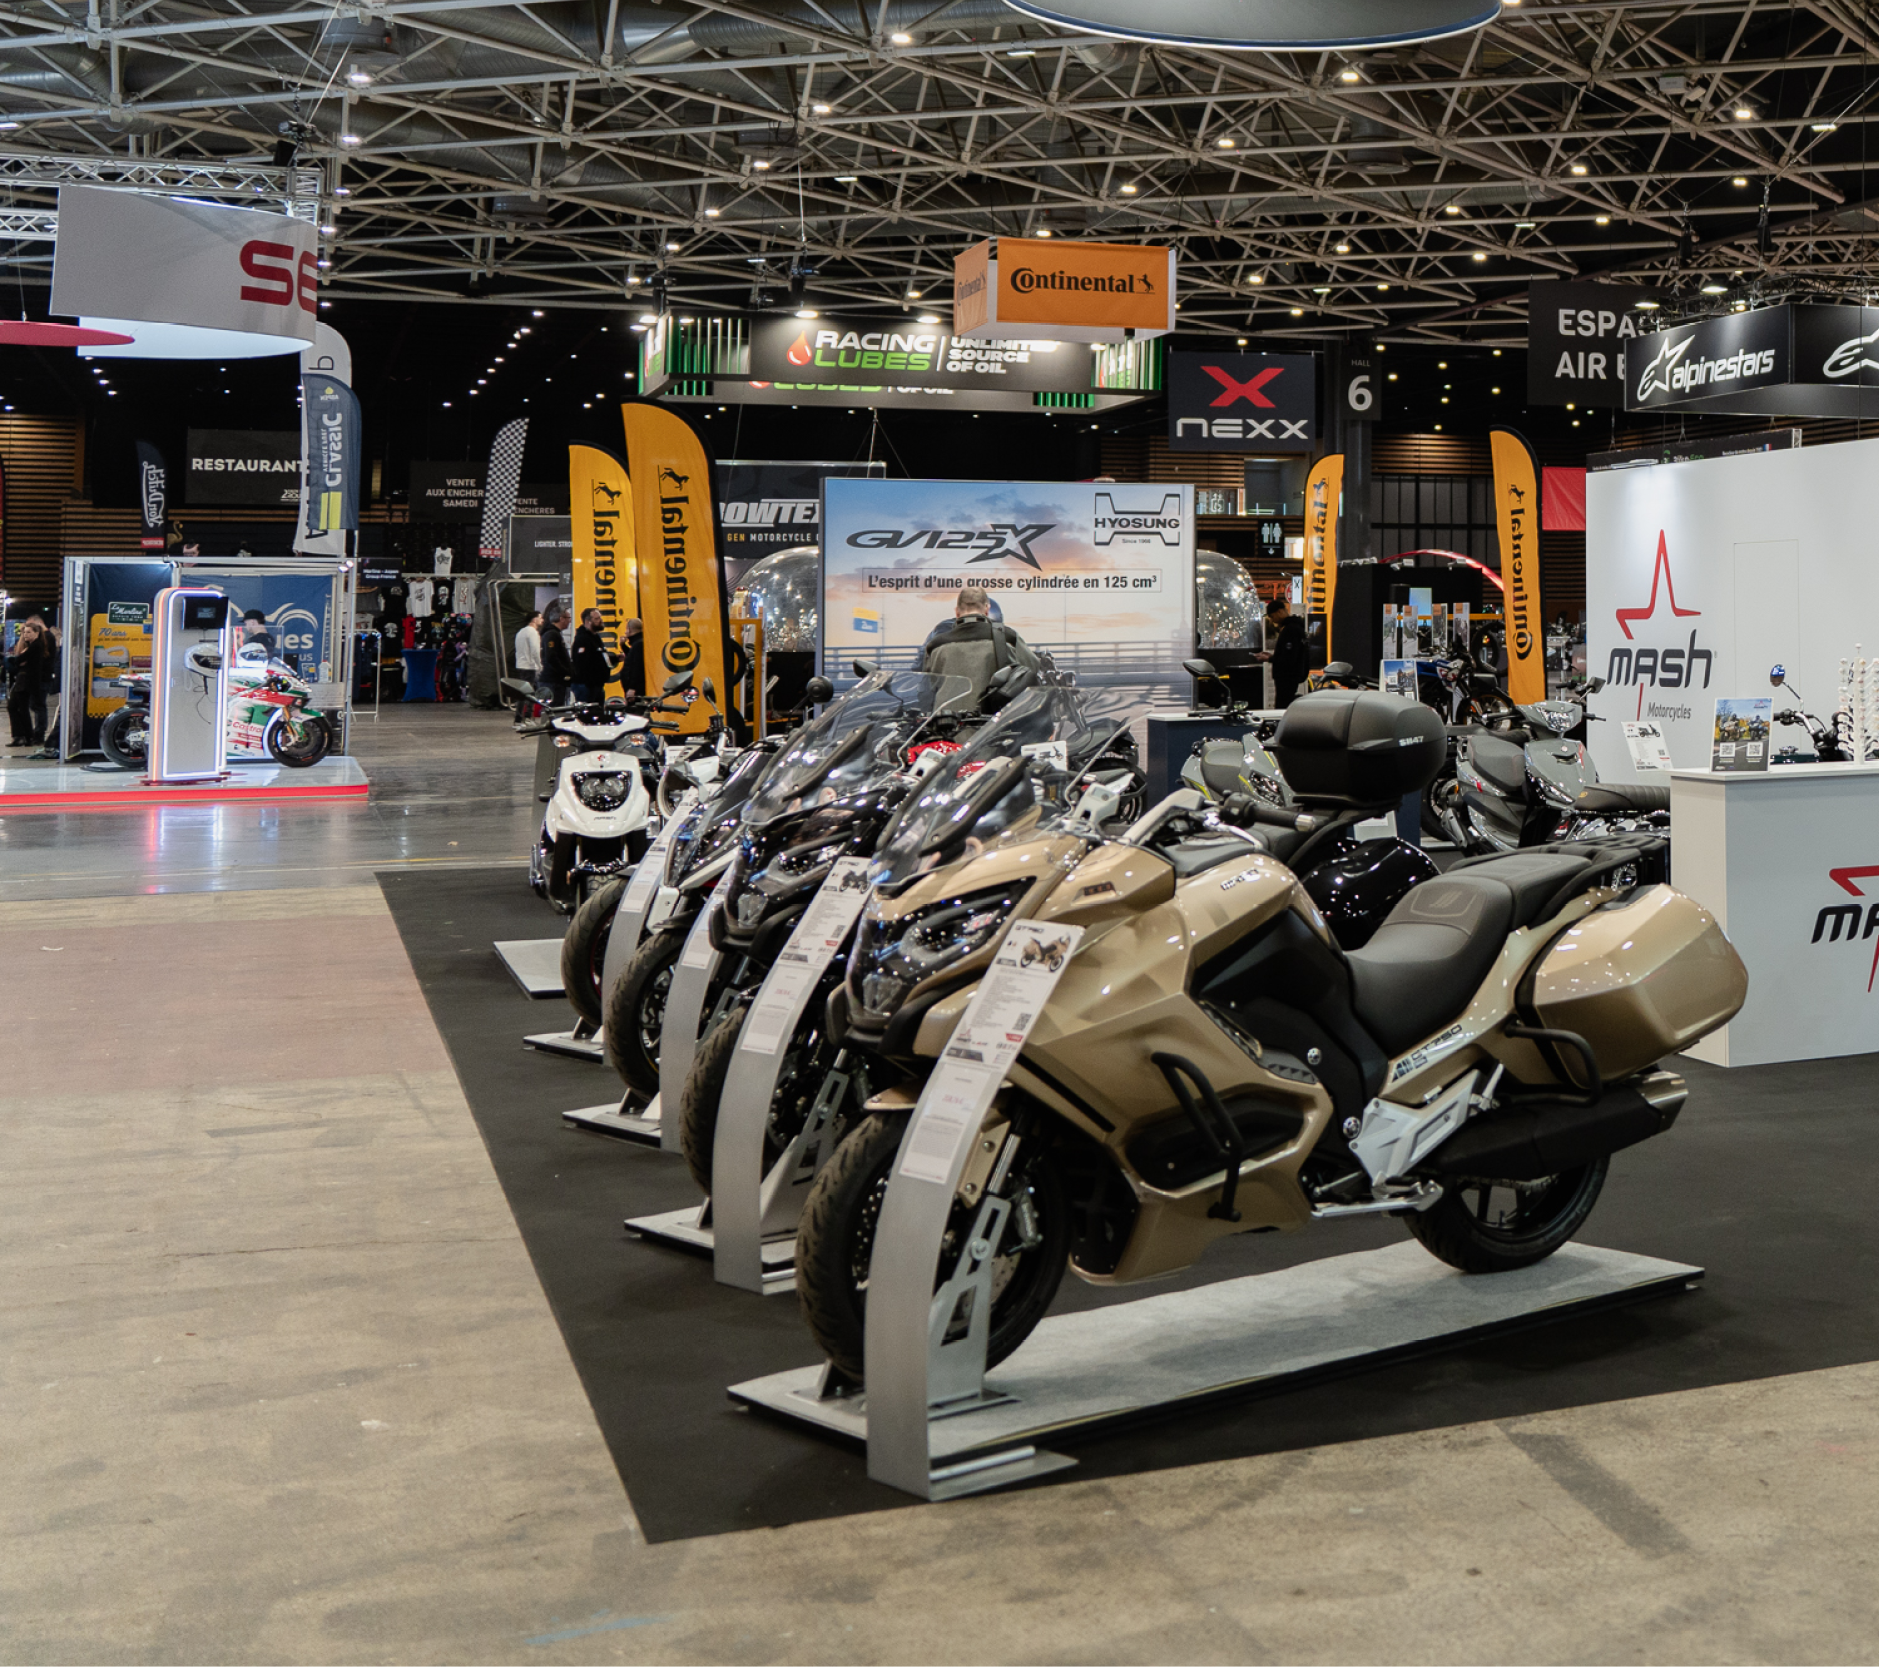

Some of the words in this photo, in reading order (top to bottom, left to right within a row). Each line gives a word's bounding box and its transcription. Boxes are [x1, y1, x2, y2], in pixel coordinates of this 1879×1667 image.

[1010, 267, 1135, 294] Continental
[814, 329, 937, 352] RACING
[813, 349, 932, 371] LUBES
[948, 349, 1030, 363] SOURCE
[1351, 359, 1371, 367] HALL
[946, 361, 973, 373] OF
[974, 362, 1007, 374] OIL
[1555, 351, 1607, 380] AIR
[1671, 348, 1776, 393] alpinestars
[1347, 375, 1373, 411] 6
[446, 478, 476, 487] VENTE
[426, 489, 445, 497] AUX
[443, 500, 478, 508] SAMEDI
[1094, 517, 1181, 530] HYOSUNG
[727, 533, 745, 542] GEN
[750, 533, 812, 542] MOTORCYCLE
[868, 574, 920, 590] L'esprit
[923, 574, 963, 589] d'une
[1017, 574, 1079, 592] cylindrée
[1083, 578, 1099, 588] en
[1104, 575, 1128, 588] 125
[99, 627, 112, 636] 70
[1646, 701, 1692, 722] Motorcycles
